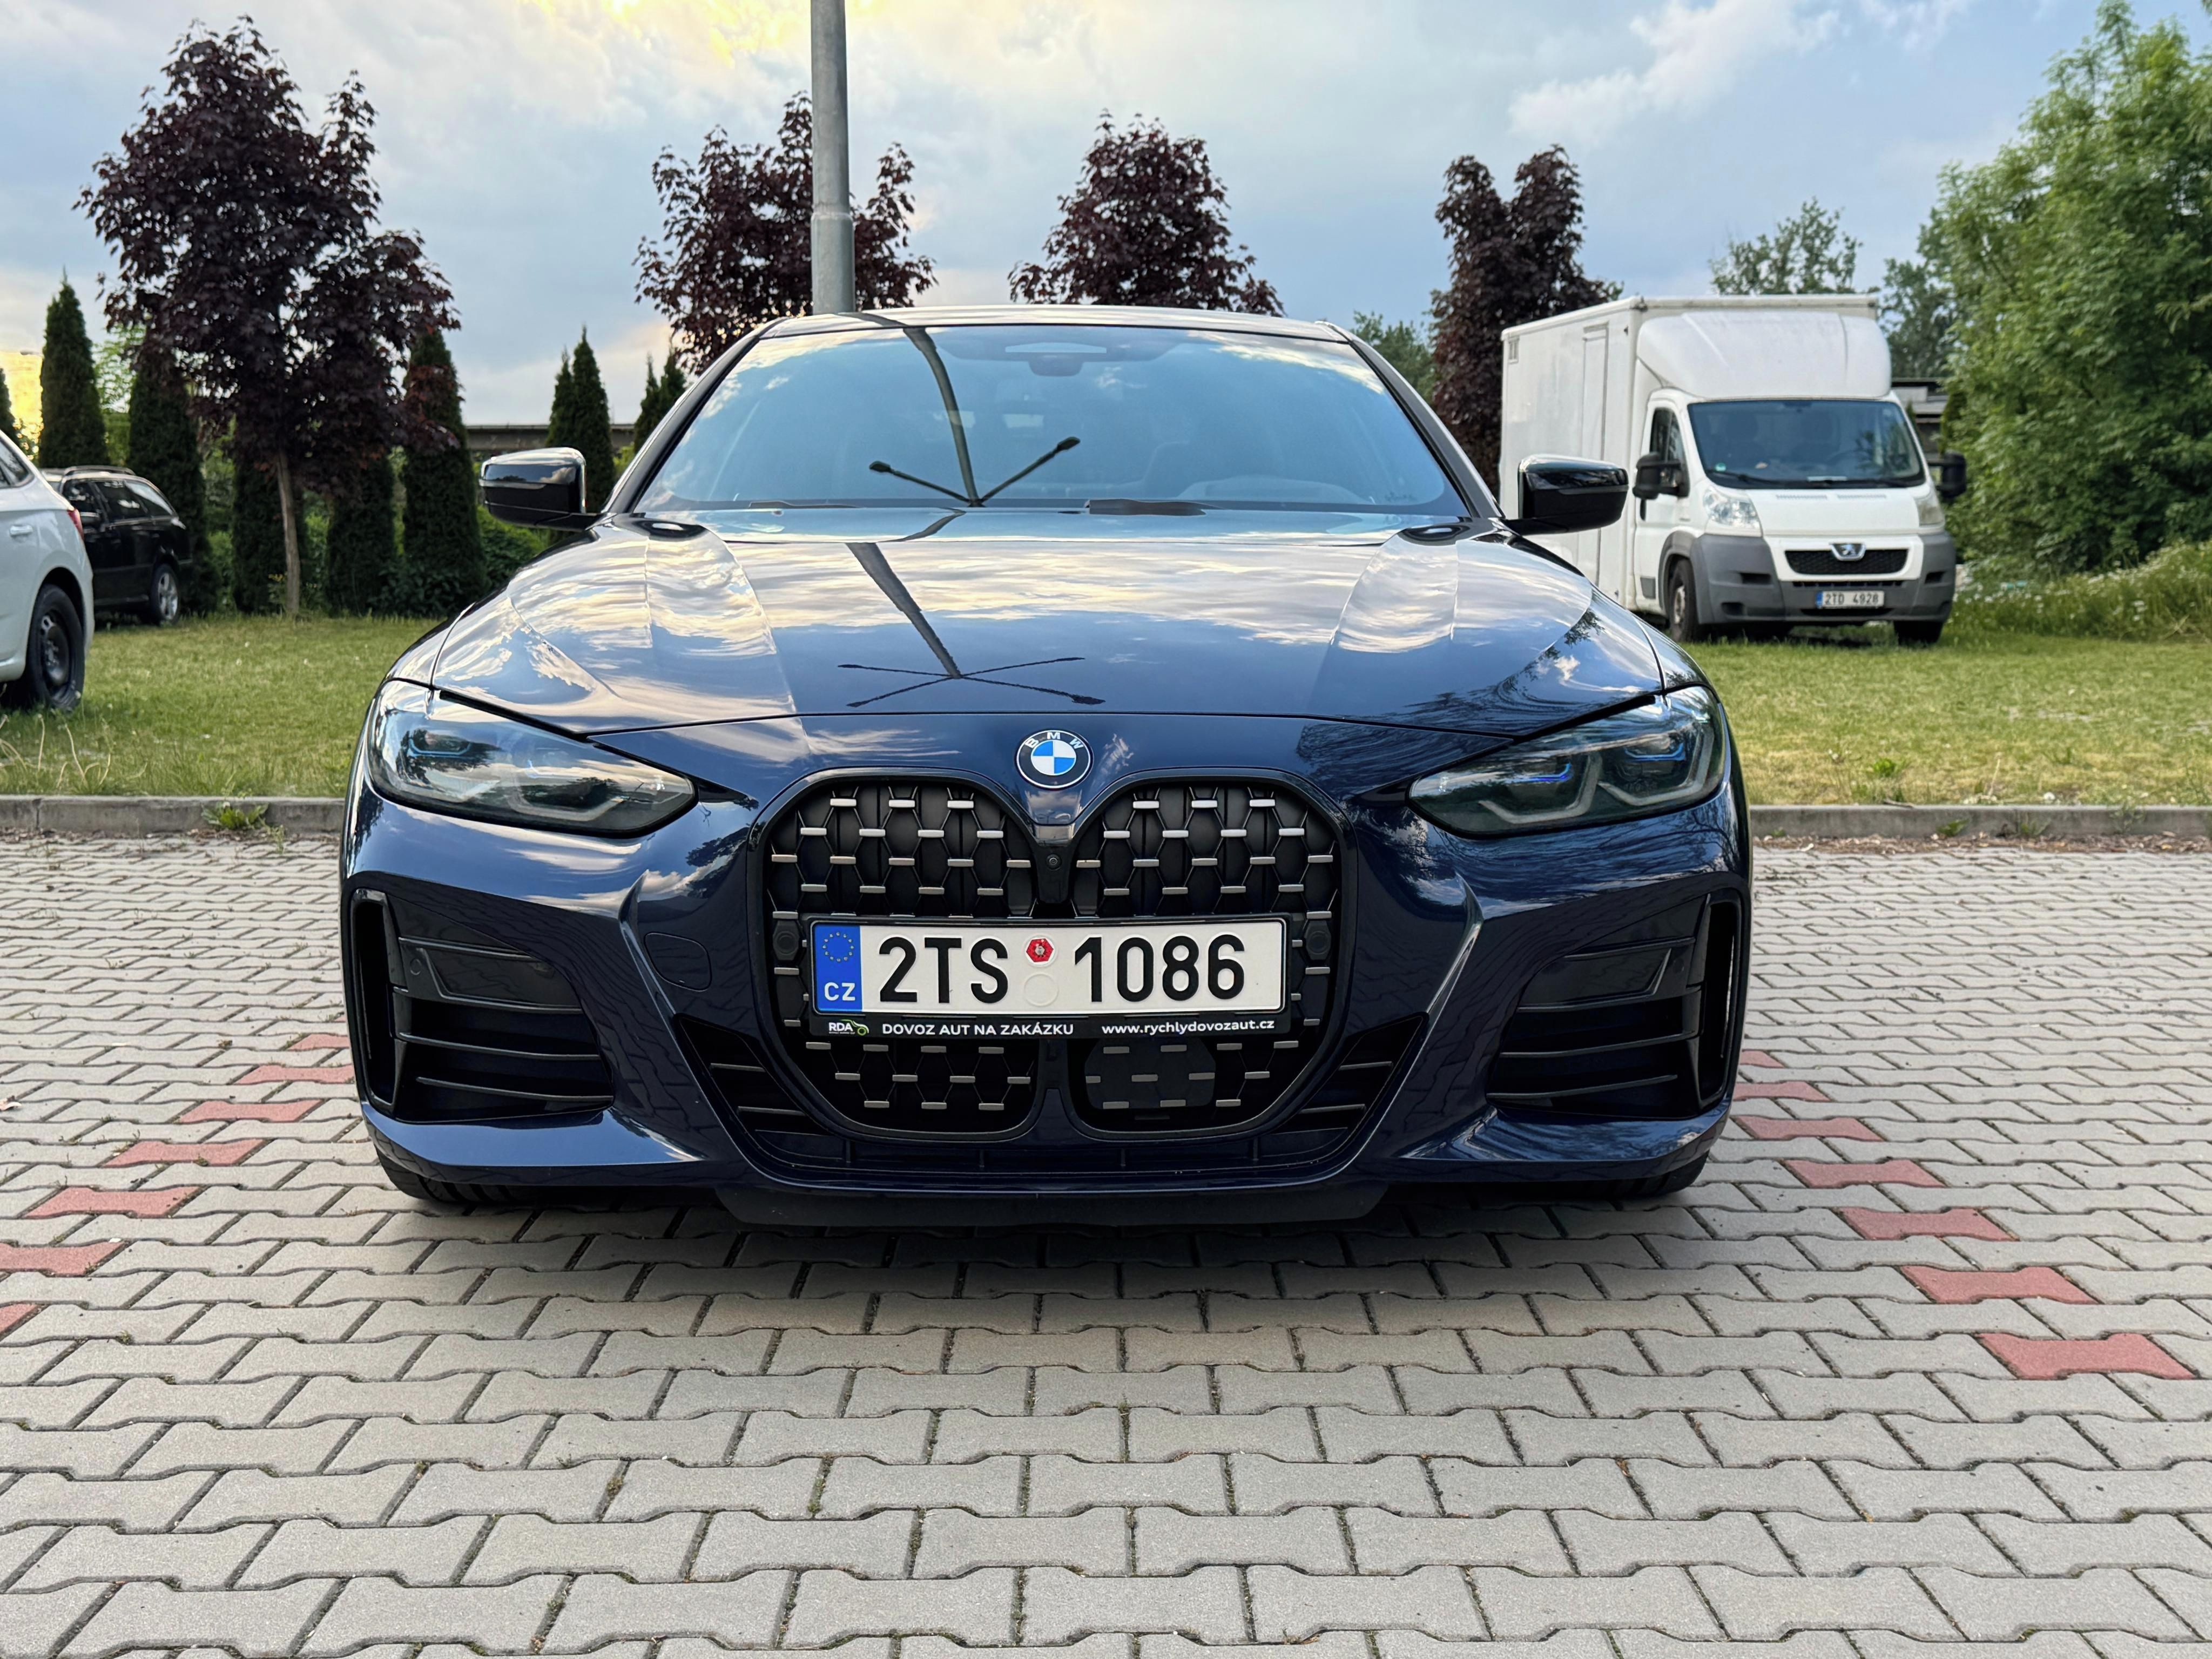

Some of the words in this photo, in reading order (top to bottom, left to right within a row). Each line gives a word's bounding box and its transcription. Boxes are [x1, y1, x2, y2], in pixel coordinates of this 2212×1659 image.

[1853, 593, 1879, 605] 4928
[1025, 732, 1084, 749] BMW
[879, 936, 1008, 1004] 2TS
[1075, 934, 1245, 1002] 1086
[824, 982, 856, 1001] CZ
[828, 1022, 853, 1031] RDA
[882, 1024, 935, 1035] DOVOZ
[939, 1024, 970, 1035] AUT
[974, 1024, 997, 1035] NA
[1000, 1022, 1074, 1035] ZAKÁZKU
[1102, 1020, 1274, 1035] www.rychlydovozaut.cz
